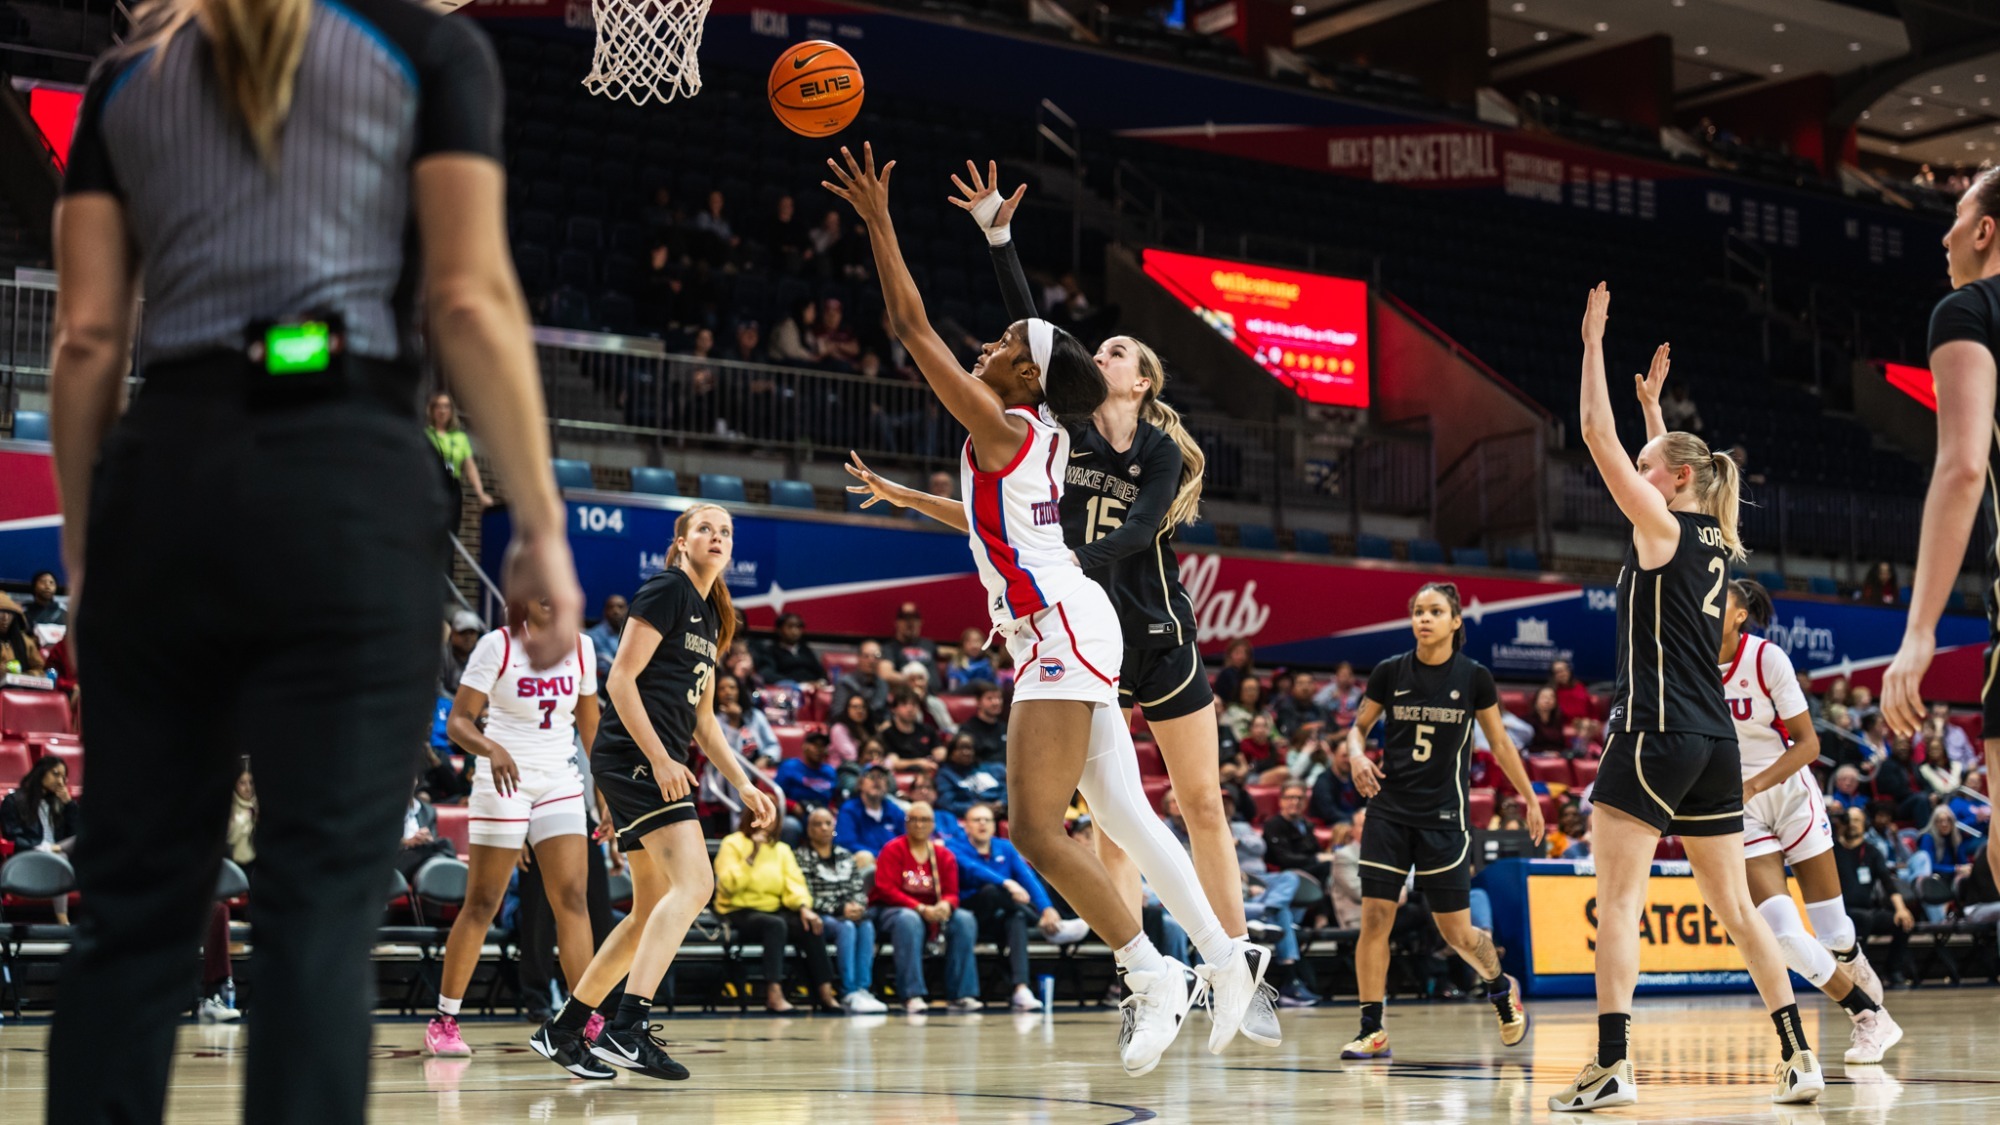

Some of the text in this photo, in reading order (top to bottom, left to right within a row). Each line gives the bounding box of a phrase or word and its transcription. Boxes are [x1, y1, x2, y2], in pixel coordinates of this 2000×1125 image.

[800, 75, 851, 98] ELITE
[1372, 133, 1499, 183] BASKETBALL
[1066, 465, 1104, 489] WAKE
[577, 506, 624, 533] 104
[1085, 496, 1127, 545] 15
[1702, 556, 1725, 619] 2
[684, 632, 708, 656] WAKE
[1765, 614, 1835, 656] rhythm
[517, 676, 573, 698] SMU
[539, 700, 557, 729] 7
[1392, 705, 1466, 724] WAKE FOREST
[1412, 724, 1435, 762] 5
[1585, 897, 1737, 953] SATGE
[1691, 972, 1721, 985] Medical
[1724, 972, 1750, 985] Center
